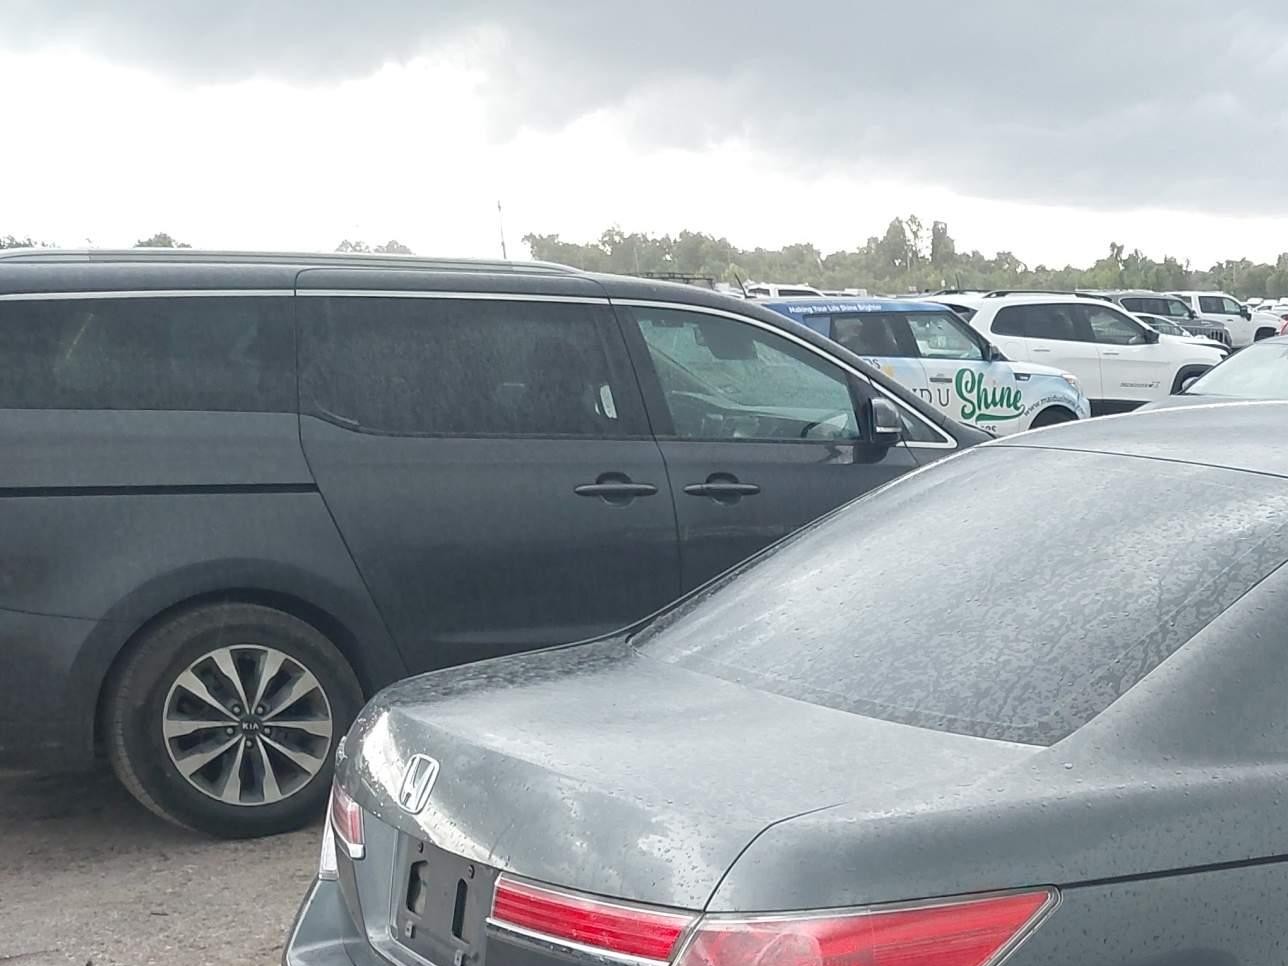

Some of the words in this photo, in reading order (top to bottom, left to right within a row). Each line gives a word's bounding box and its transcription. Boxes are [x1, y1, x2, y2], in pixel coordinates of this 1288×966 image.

[937, 388, 950, 407] U
[955, 368, 1024, 420] Shine
[242, 722, 259, 730] KIA
